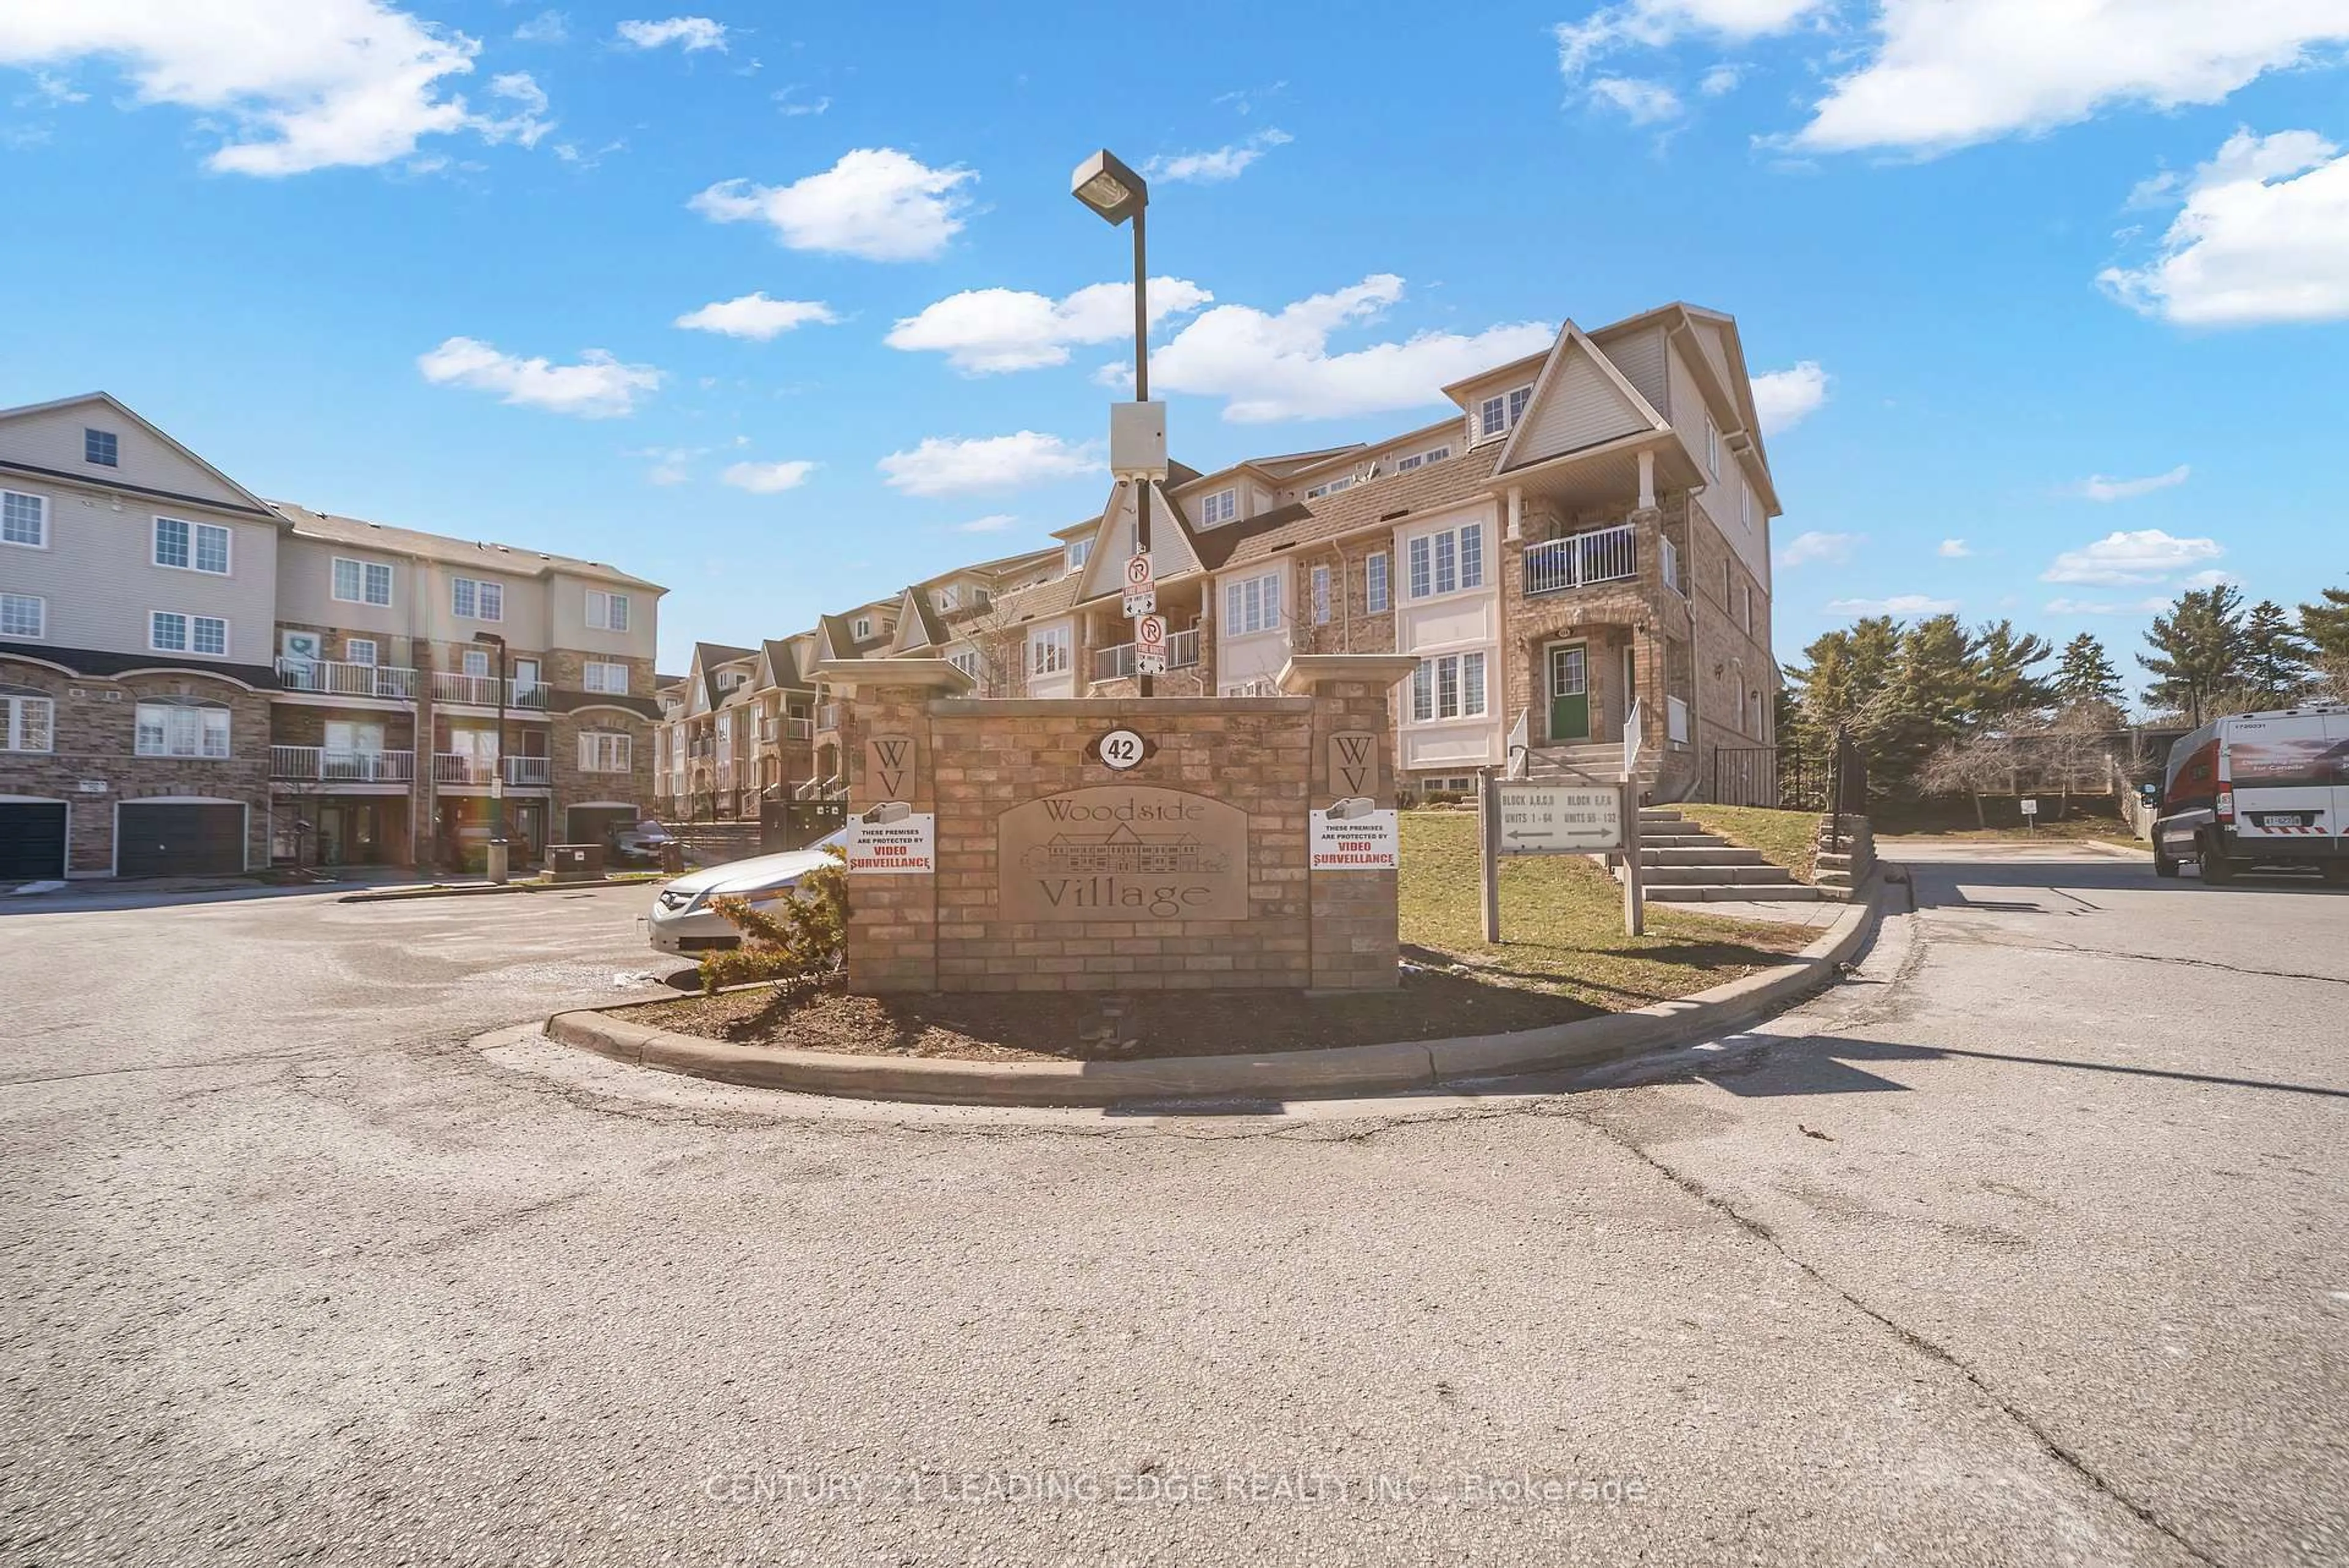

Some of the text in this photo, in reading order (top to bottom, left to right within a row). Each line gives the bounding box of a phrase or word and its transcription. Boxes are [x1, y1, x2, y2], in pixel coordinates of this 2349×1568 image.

[872, 741, 908, 769] W
[1108, 739, 1134, 760] 42
[1332, 737, 1373, 764] W
[877, 771, 907, 797] V
[1340, 767, 1371, 794] V
[1042, 797, 1205, 822] Woodside
[1502, 795, 1526, 806] BLOCK
[1505, 813, 1527, 823] UNITS
[874, 846, 907, 856] VIDEO
[1338, 841, 1371, 852] VIDEO
[850, 857, 930, 868] SURVEILLANCE
[1314, 854, 1394, 864] SURVEILLANCE
[1039, 876, 1214, 918] Village
